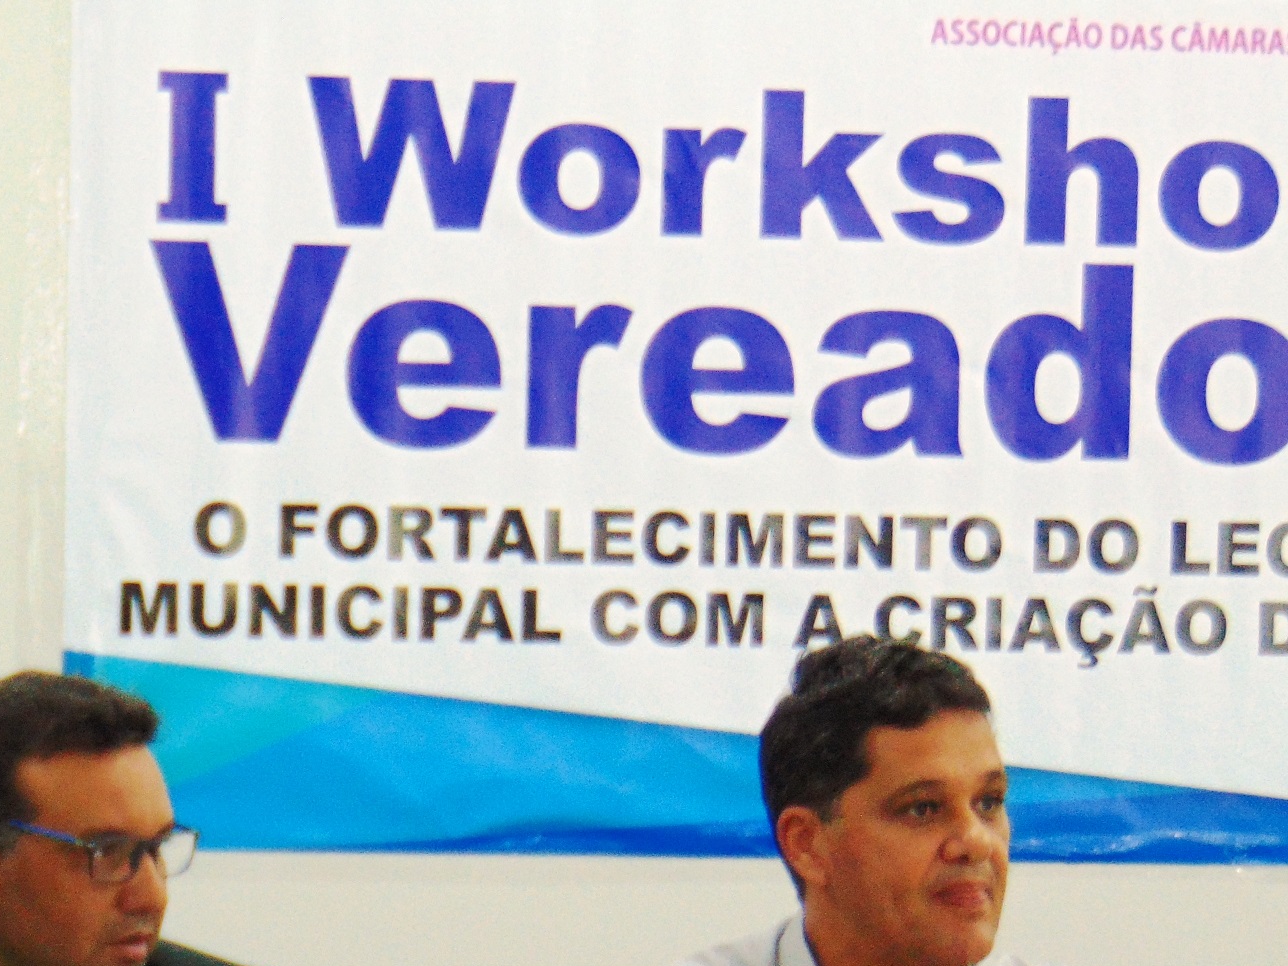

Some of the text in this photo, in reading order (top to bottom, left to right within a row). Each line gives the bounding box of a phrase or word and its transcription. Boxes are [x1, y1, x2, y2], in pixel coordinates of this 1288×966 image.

[931, 18, 1288, 54] ASSOCIAÇÃO DAS CÂMARA
[157, 70, 1280, 251] I Worksho
[150, 239, 1288, 466] Vereado
[193, 501, 246, 558] O
[278, 503, 1002, 572] FORTALECIMENTO
[1034, 518, 1139, 574] DO
[118, 580, 562, 644] MUNICIPAL
[591, 590, 764, 647] COM
[792, 594, 843, 649] A
[874, 586, 1227, 667] CRIAÇÃO
